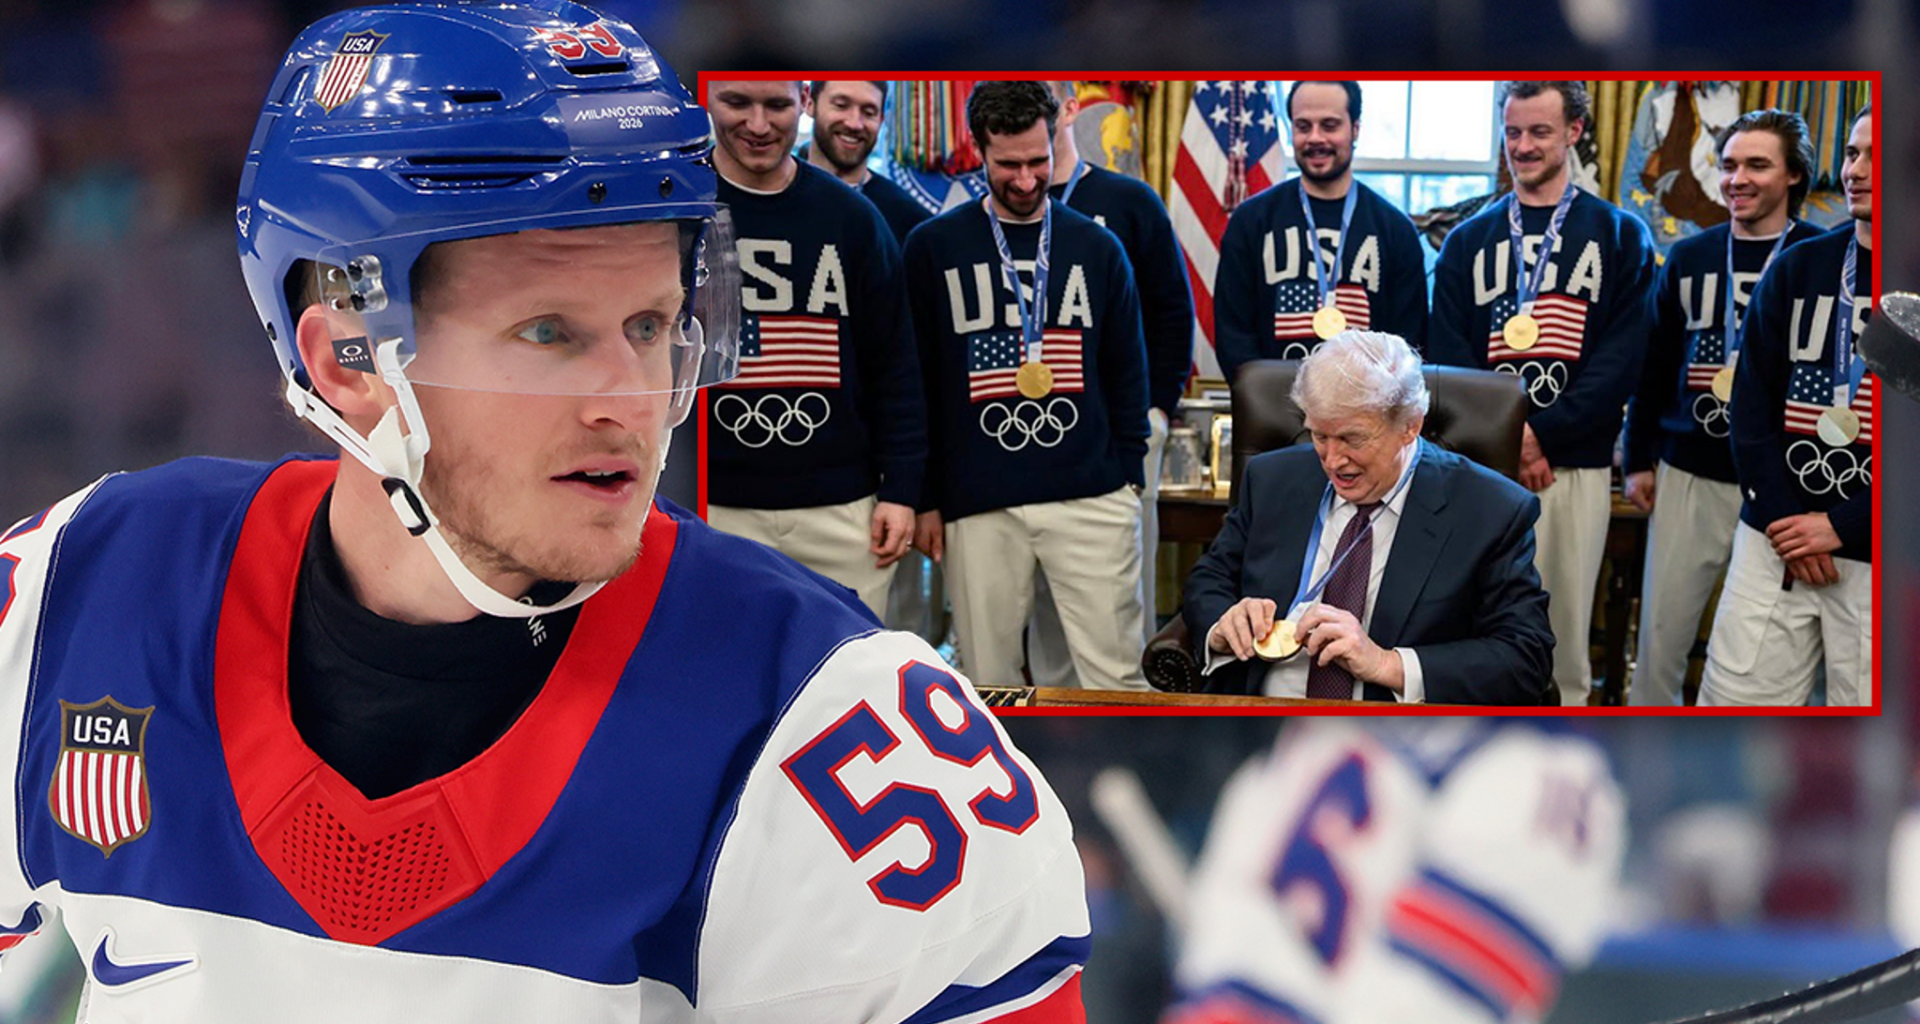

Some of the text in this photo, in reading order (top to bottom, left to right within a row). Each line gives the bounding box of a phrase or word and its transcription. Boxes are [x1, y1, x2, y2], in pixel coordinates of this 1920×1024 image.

[343, 37, 375, 52] USA
[574, 107, 626, 121] MILANO
[618, 118, 643, 129] 2026
[736, 238, 849, 316] SA
[1262, 226, 1380, 293] USA
[1473, 234, 1602, 306] USA
[944, 260, 1093, 334] USA
[73, 715, 130, 746] USA
[779, 659, 1040, 912] 59
